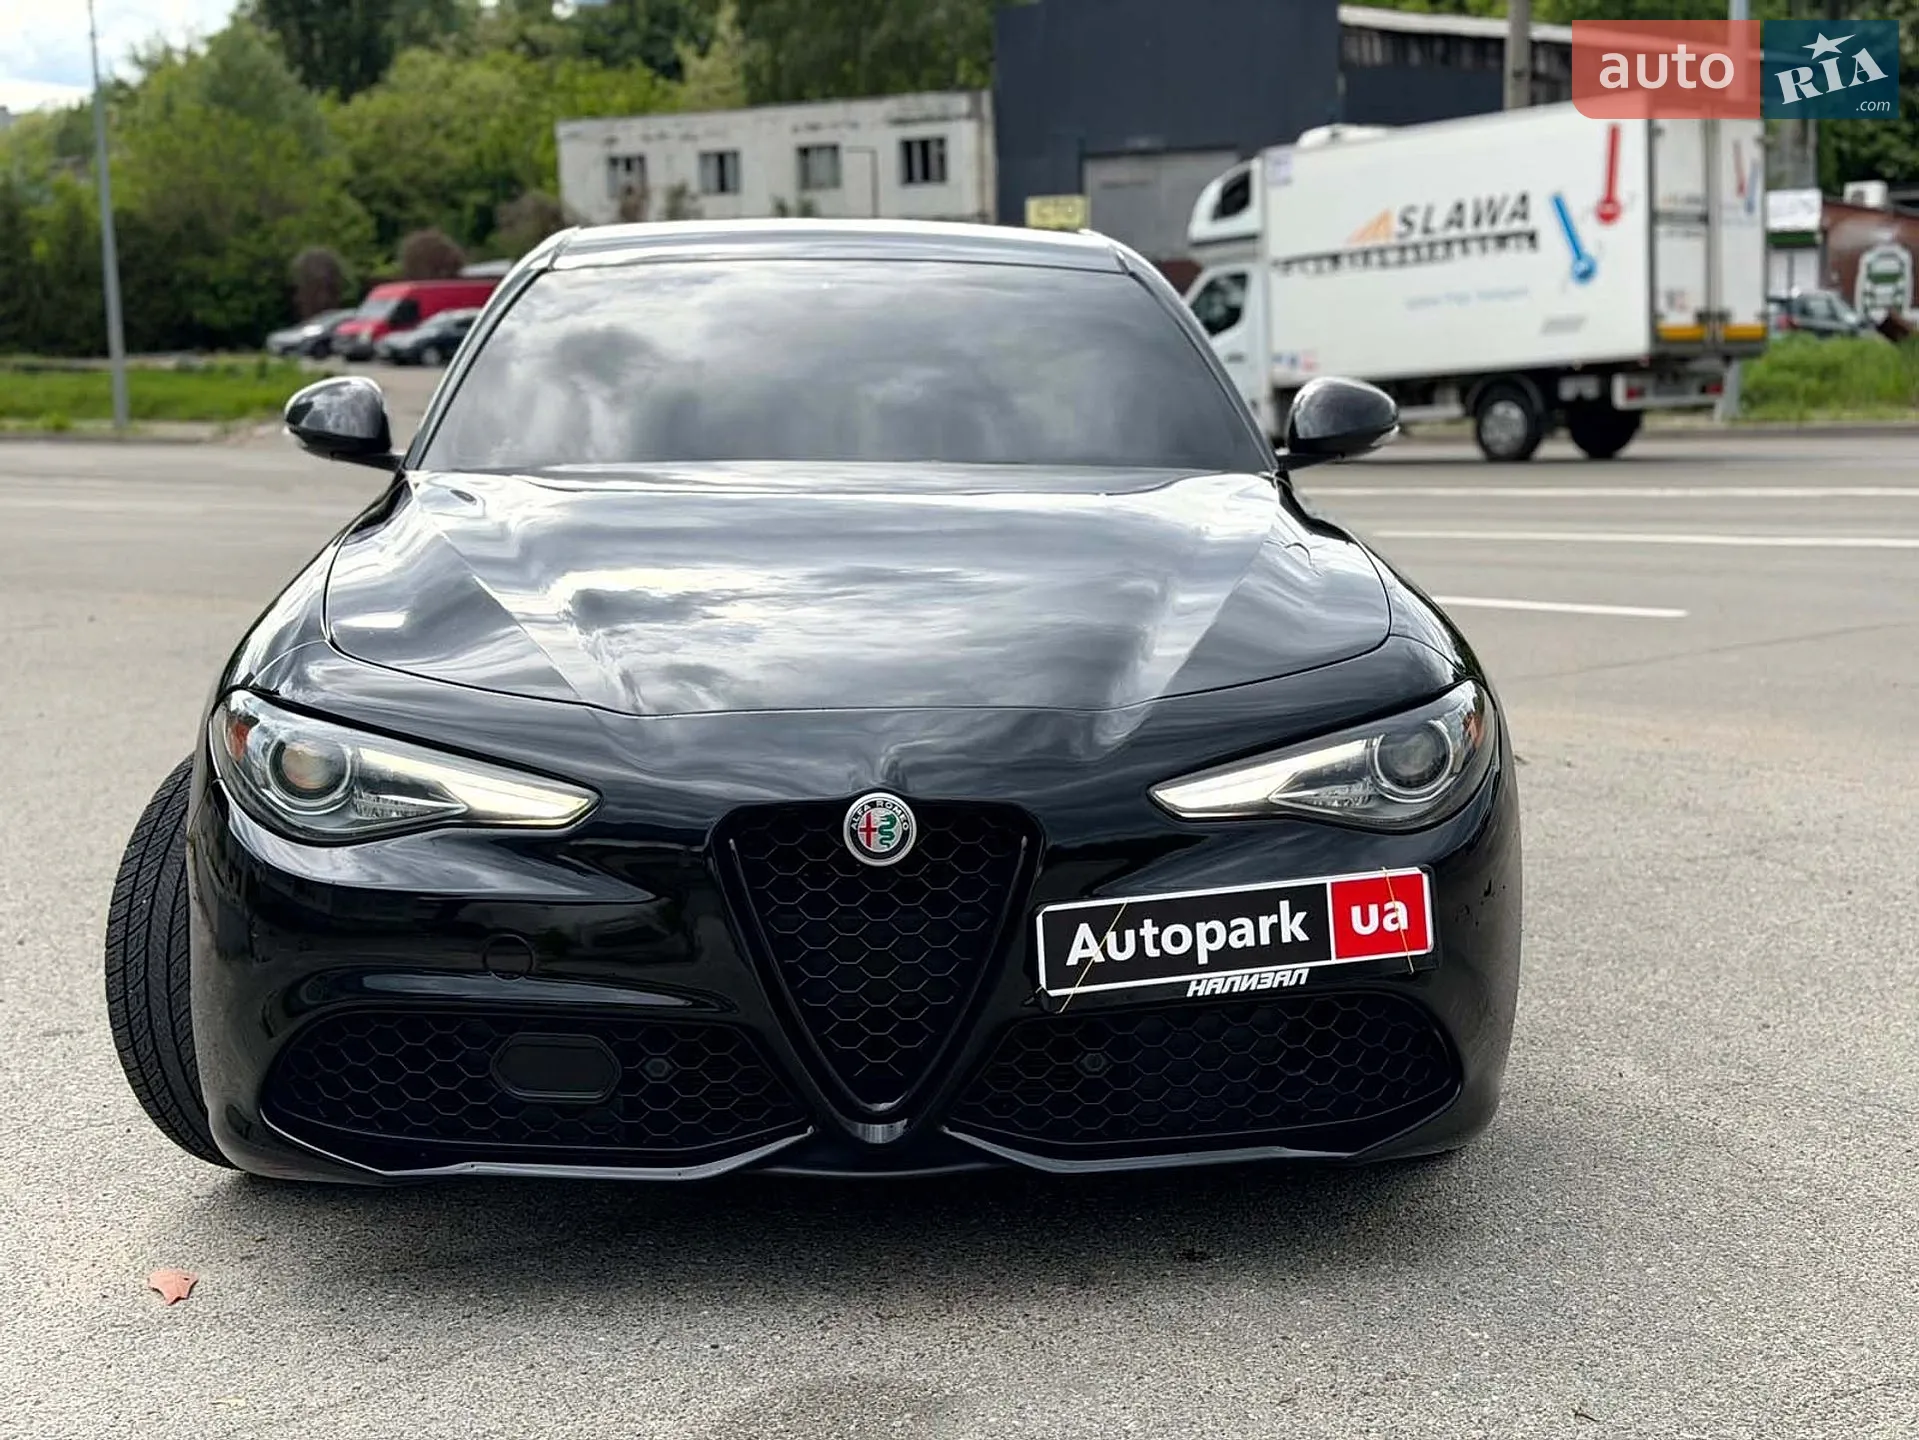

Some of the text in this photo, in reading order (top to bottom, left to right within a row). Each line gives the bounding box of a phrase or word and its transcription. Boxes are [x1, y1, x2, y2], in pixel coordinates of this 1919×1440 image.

[1396, 190, 1532, 239] SLAWA
[850, 800, 909, 831] ALFA ROMEO
[1065, 900, 1409, 965] Autopark ua
